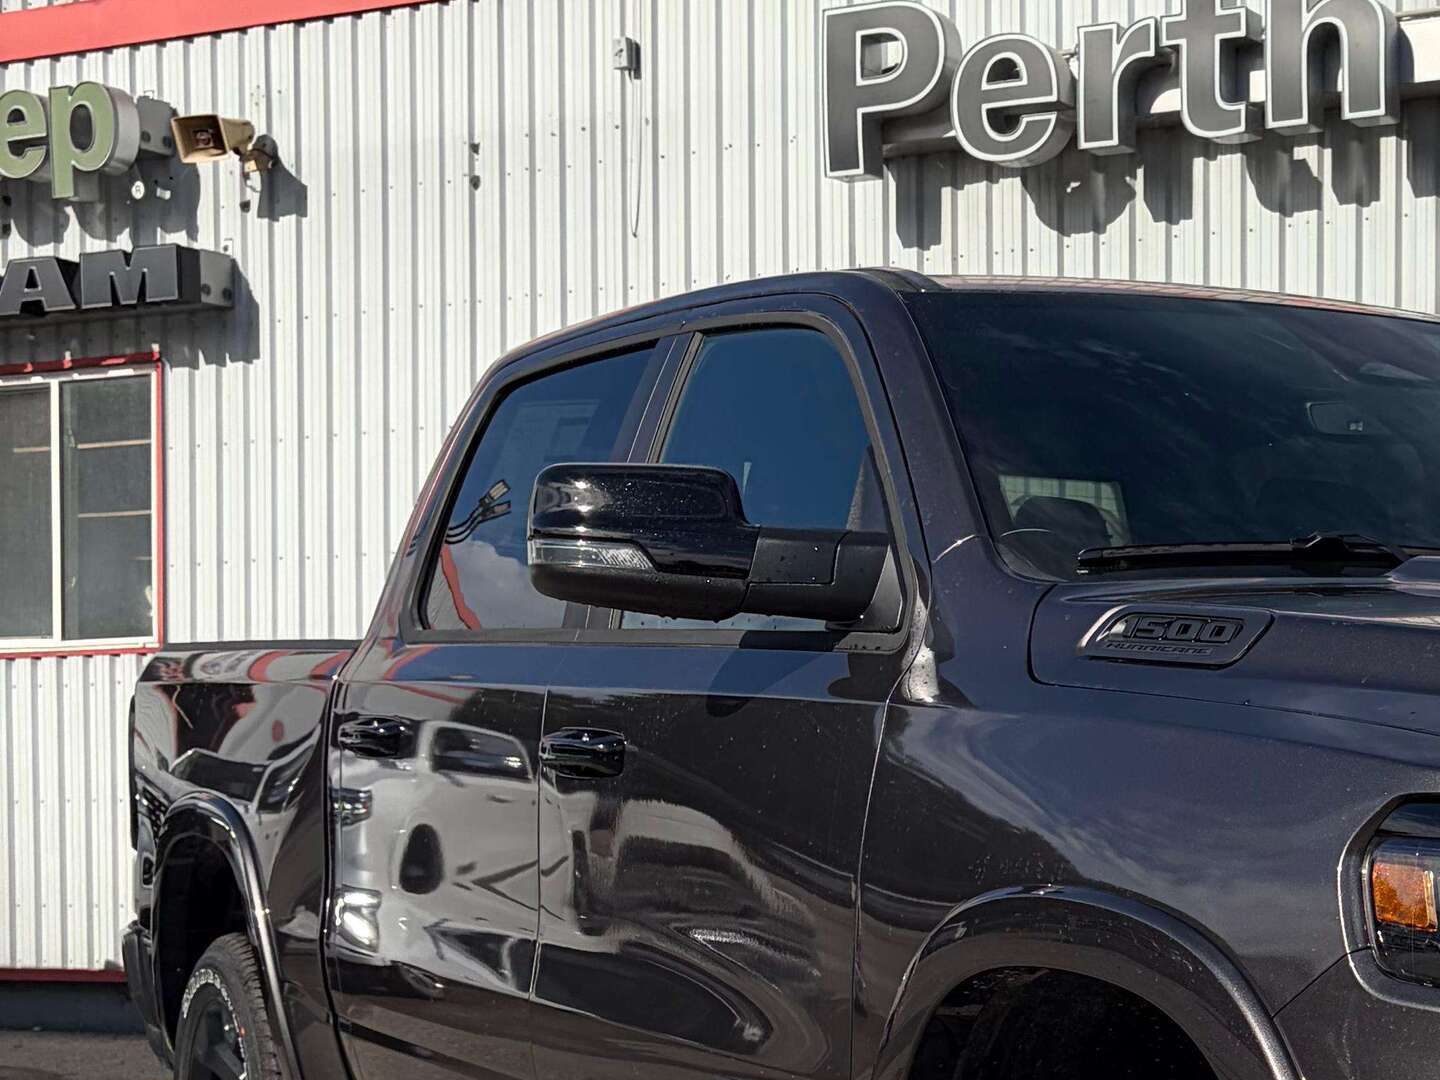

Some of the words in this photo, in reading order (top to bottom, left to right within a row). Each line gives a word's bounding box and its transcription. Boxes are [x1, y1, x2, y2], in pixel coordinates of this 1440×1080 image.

[823, 0, 1388, 181] Perth
[1105, 614, 1243, 643] 1500
[1105, 642, 1211, 656] HURRICANE
